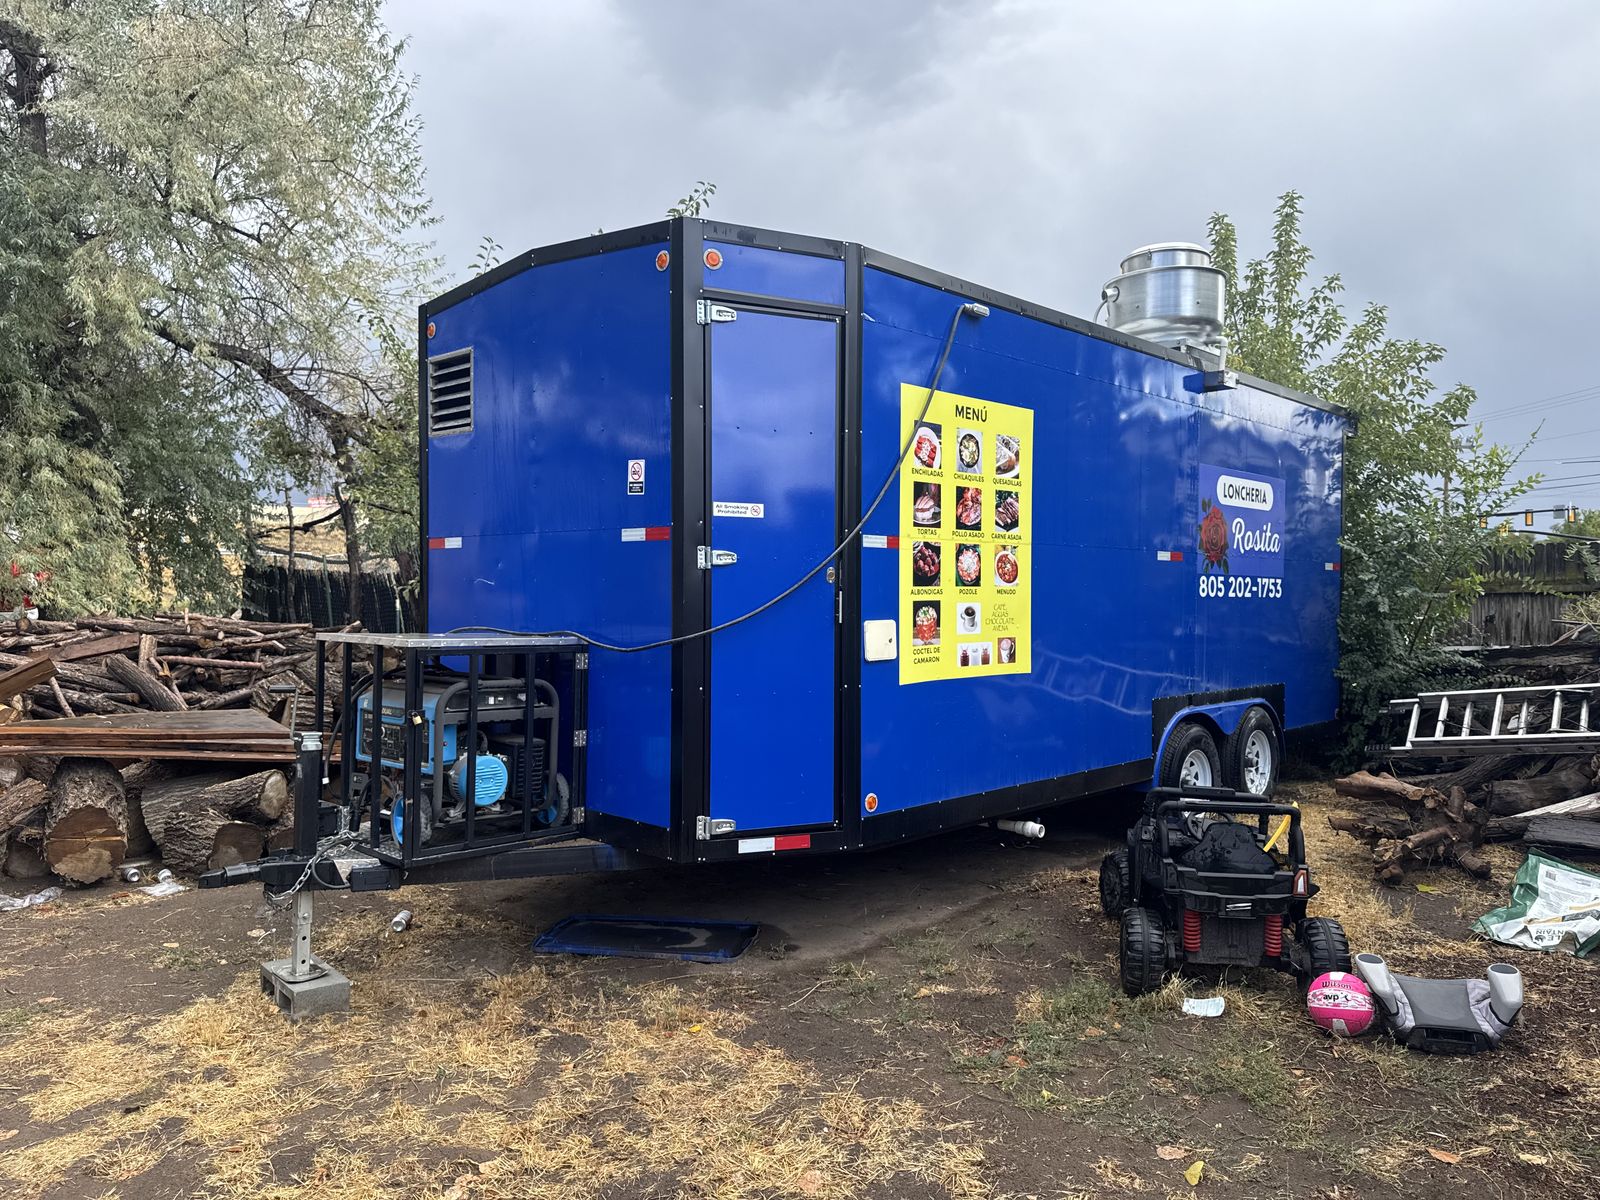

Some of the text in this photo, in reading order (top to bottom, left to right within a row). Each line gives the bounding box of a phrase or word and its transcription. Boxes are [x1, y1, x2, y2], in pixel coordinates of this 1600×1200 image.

[955, 404, 988, 422] MENÚ
[911, 468, 944, 477] ENCHILADAS
[953, 473, 985, 482] CHILAQUILES
[992, 477, 1022, 487] QUESADILLAS
[1223, 482, 1267, 504] LONCHERIA
[917, 528, 937, 536] TORTAS
[952, 530, 985, 539] POLLO ASADO
[1232, 517, 1281, 554] Rosita
[1199, 575, 1282, 598] 805 202-1753
[912, 647, 933, 655] COCTEL
[913, 656, 940, 665] CAMARON
[1323, 994, 1339, 1002] avp
